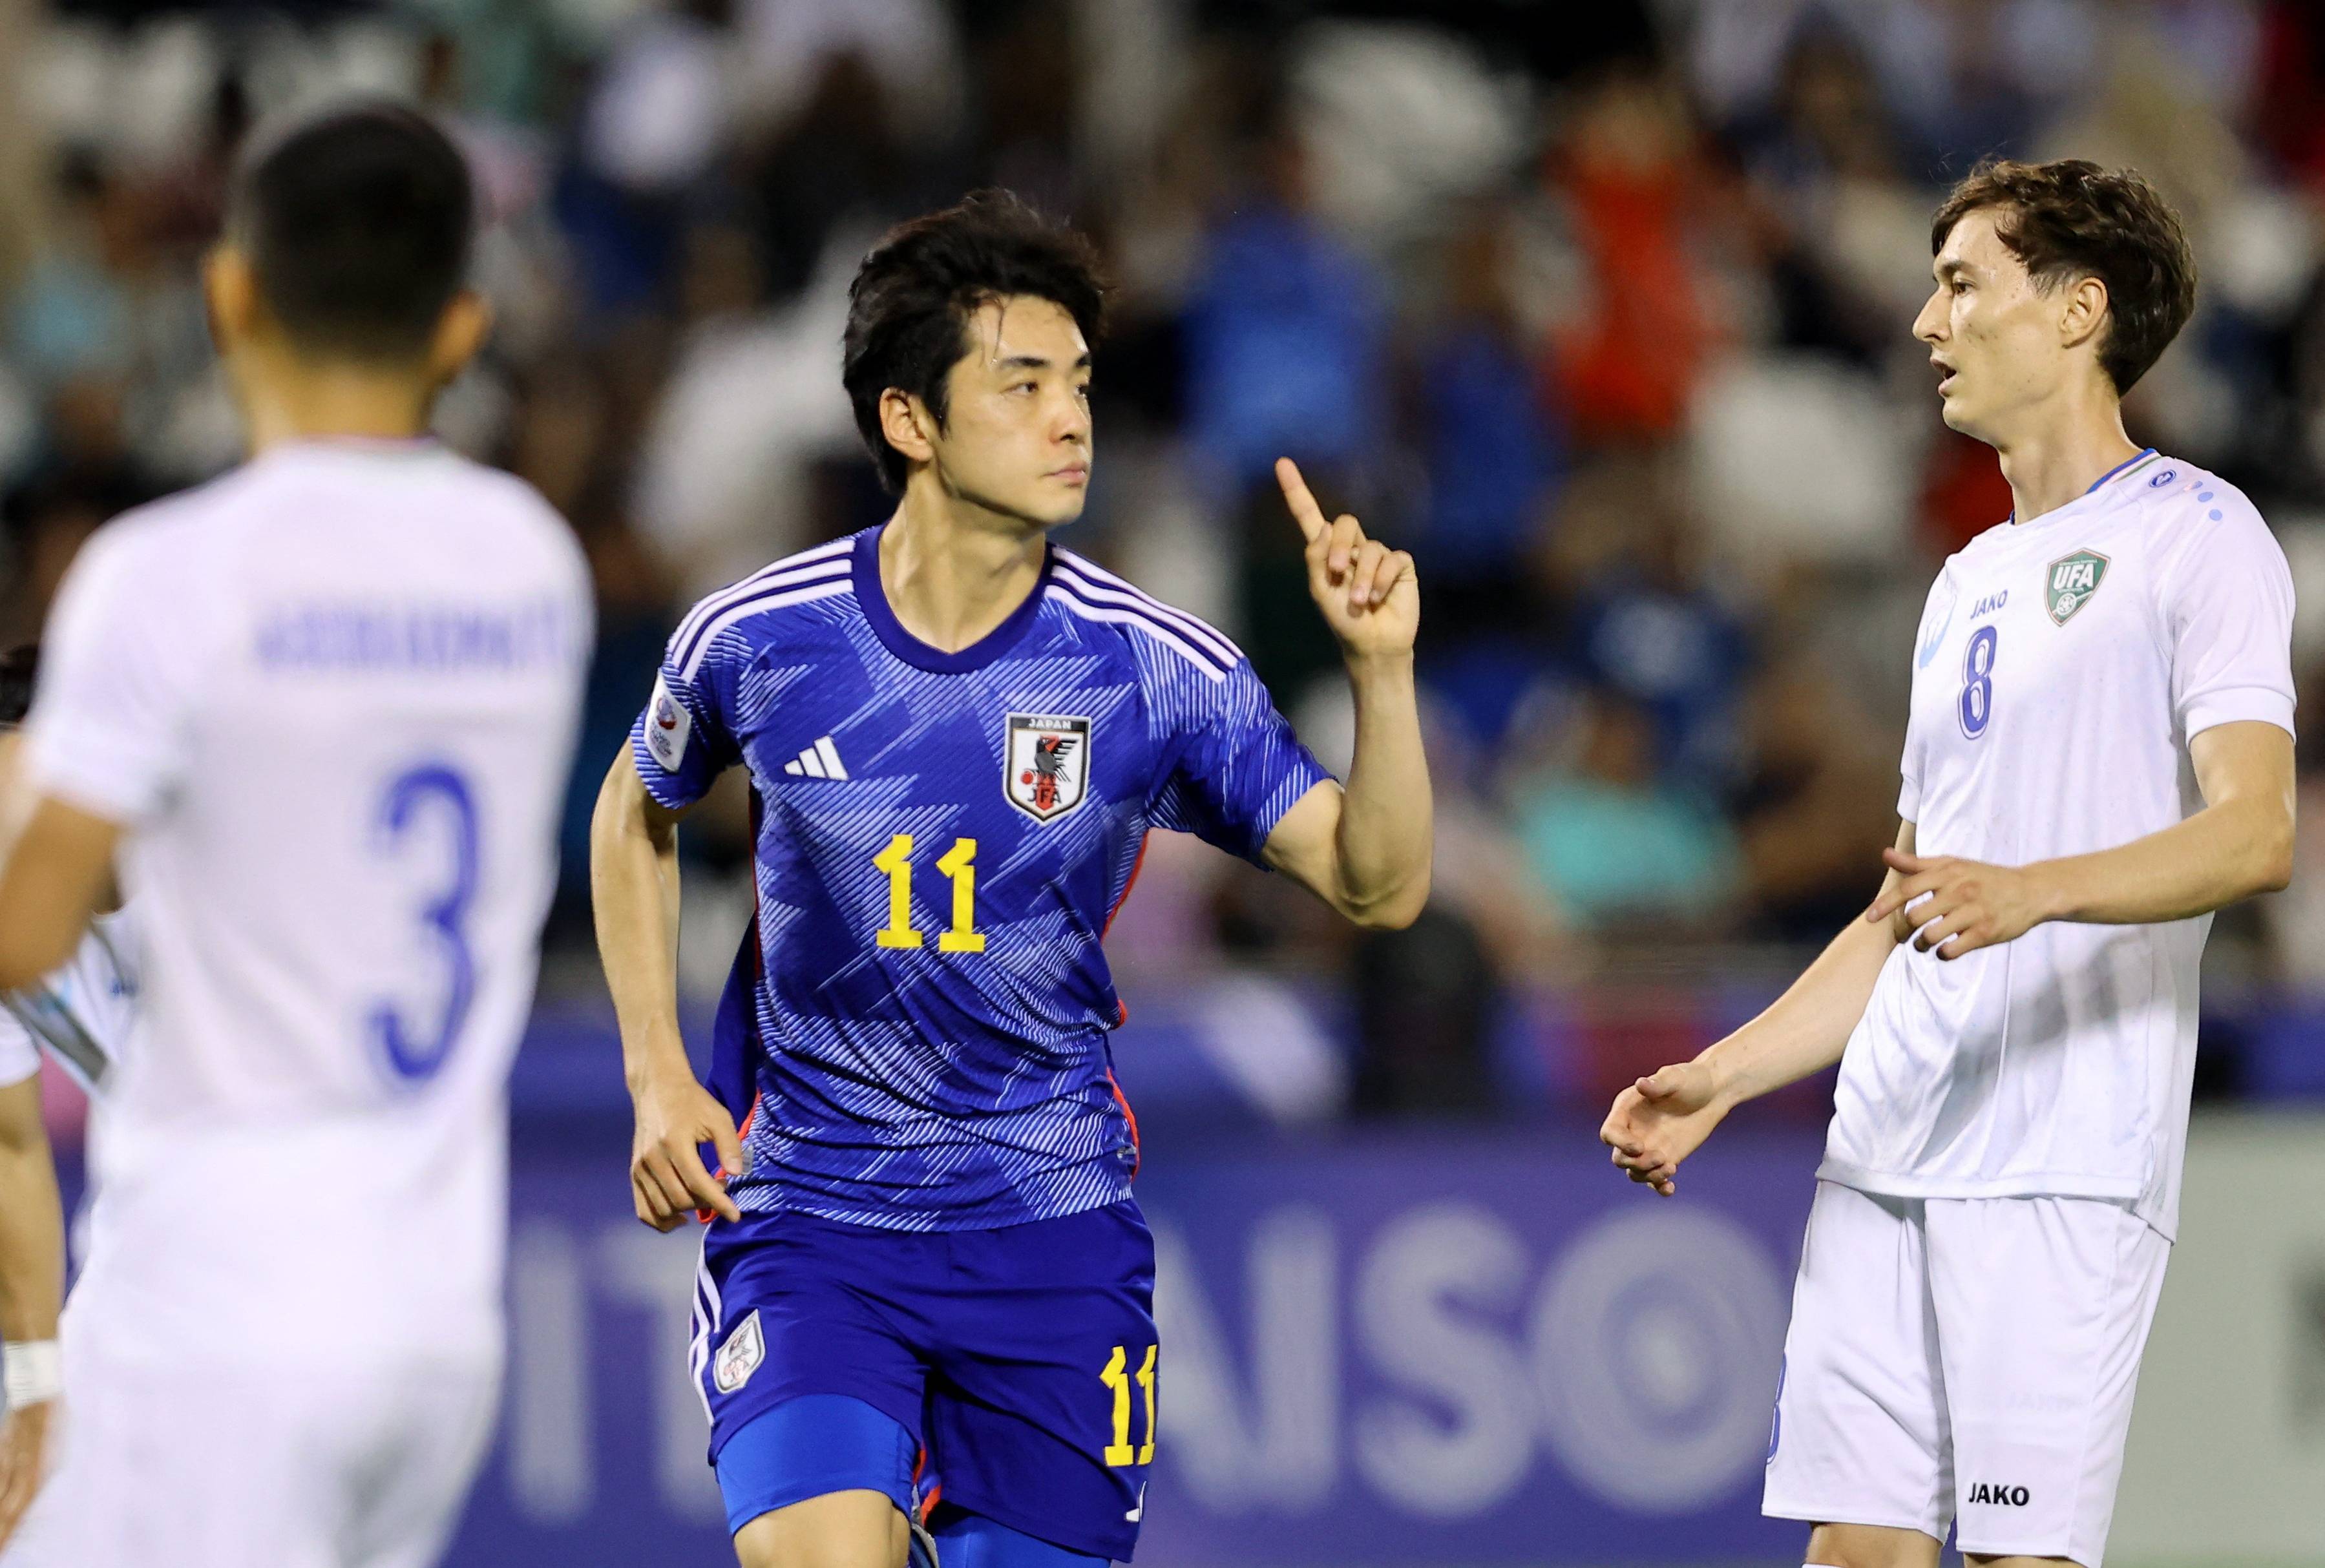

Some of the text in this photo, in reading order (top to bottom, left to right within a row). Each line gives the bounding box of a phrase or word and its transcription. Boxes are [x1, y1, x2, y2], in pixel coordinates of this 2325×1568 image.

[2053, 563, 2094, 591] UFA
[1970, 589, 2008, 620] JAKO
[1957, 625, 1997, 740] 8
[1028, 718, 1072, 730] JAPAN
[1027, 787, 1062, 804] JFA
[872, 834, 985, 953] 11
[367, 762, 478, 1082] 3
[1099, 1344, 1157, 1467] 11
[1968, 1482, 2030, 1507] JAKO
